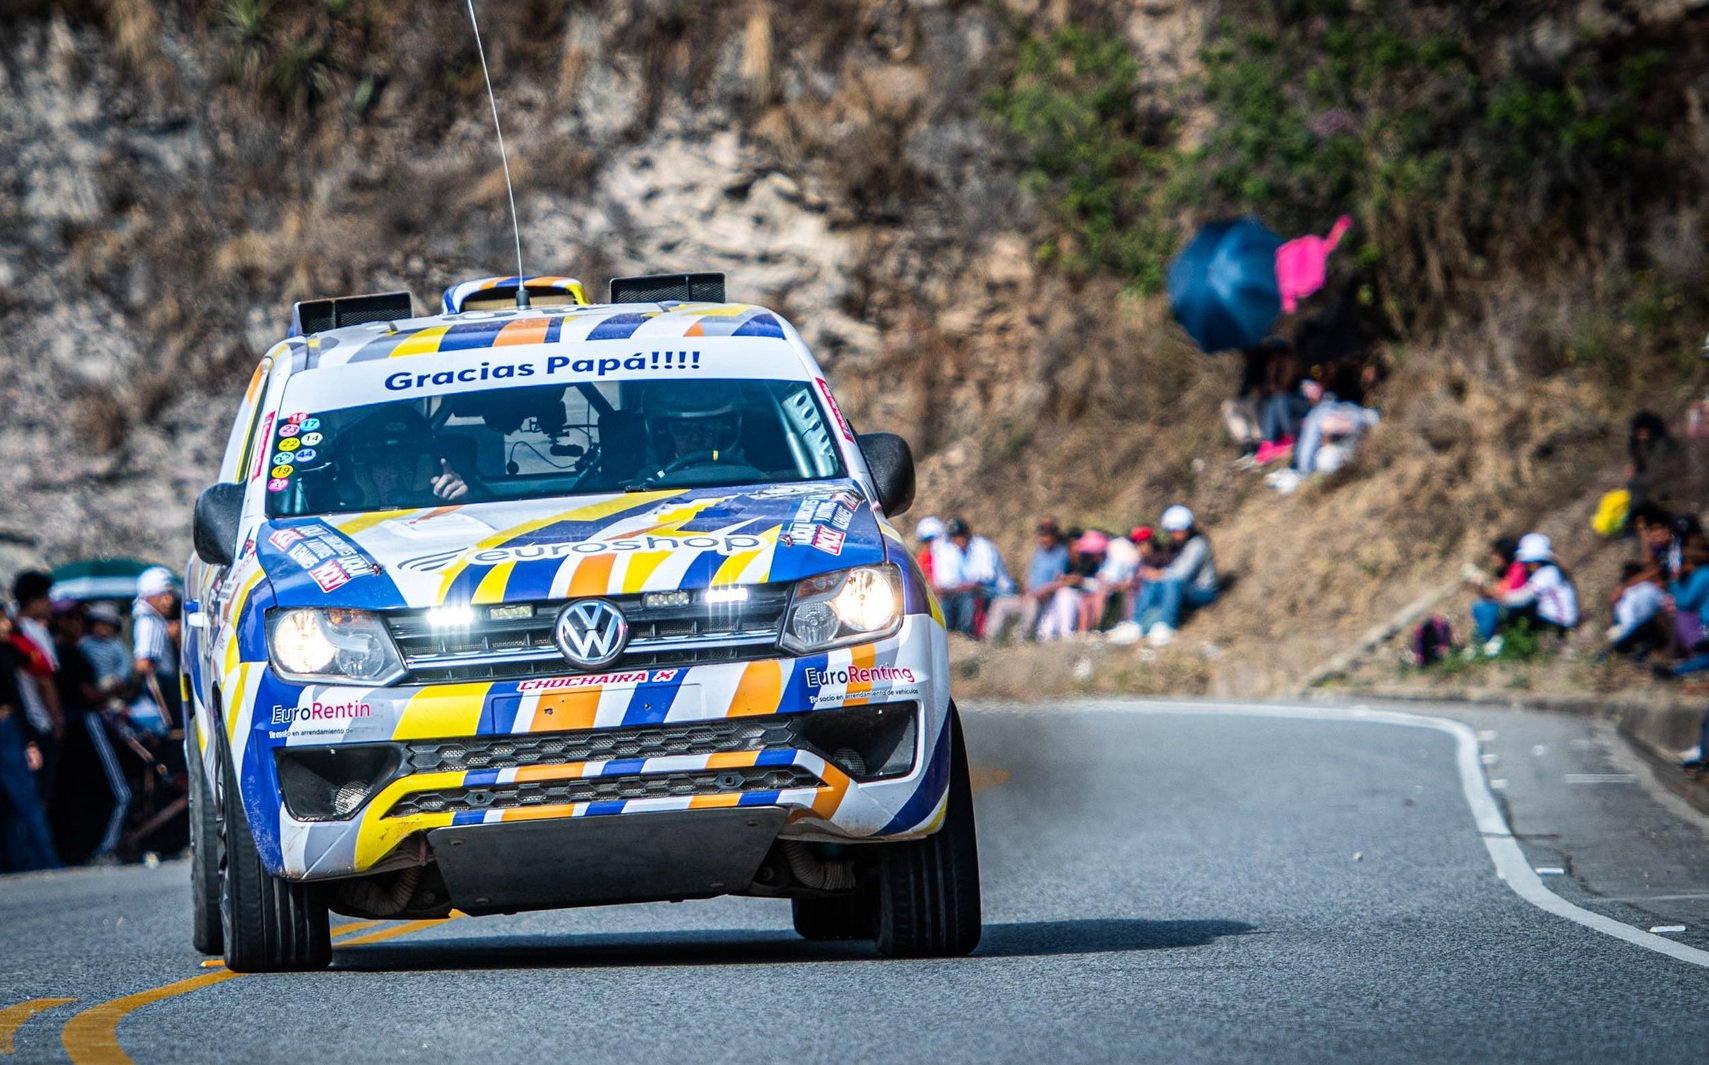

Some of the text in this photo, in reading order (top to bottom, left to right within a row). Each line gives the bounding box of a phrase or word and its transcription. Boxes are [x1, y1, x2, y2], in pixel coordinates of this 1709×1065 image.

[385, 350, 701, 391] Gracias Papá!!!!
[282, 425, 298, 434] 23
[282, 440, 298, 448] 22
[306, 434, 319, 442] 14
[297, 450, 313, 459] 44
[276, 466, 291, 475] 19
[475, 534, 760, 562] euroshop
[520, 670, 675, 690] CHOCHAIRA X
[807, 664, 916, 687] EuroRenting
[271, 699, 370, 724] EuroRentin
